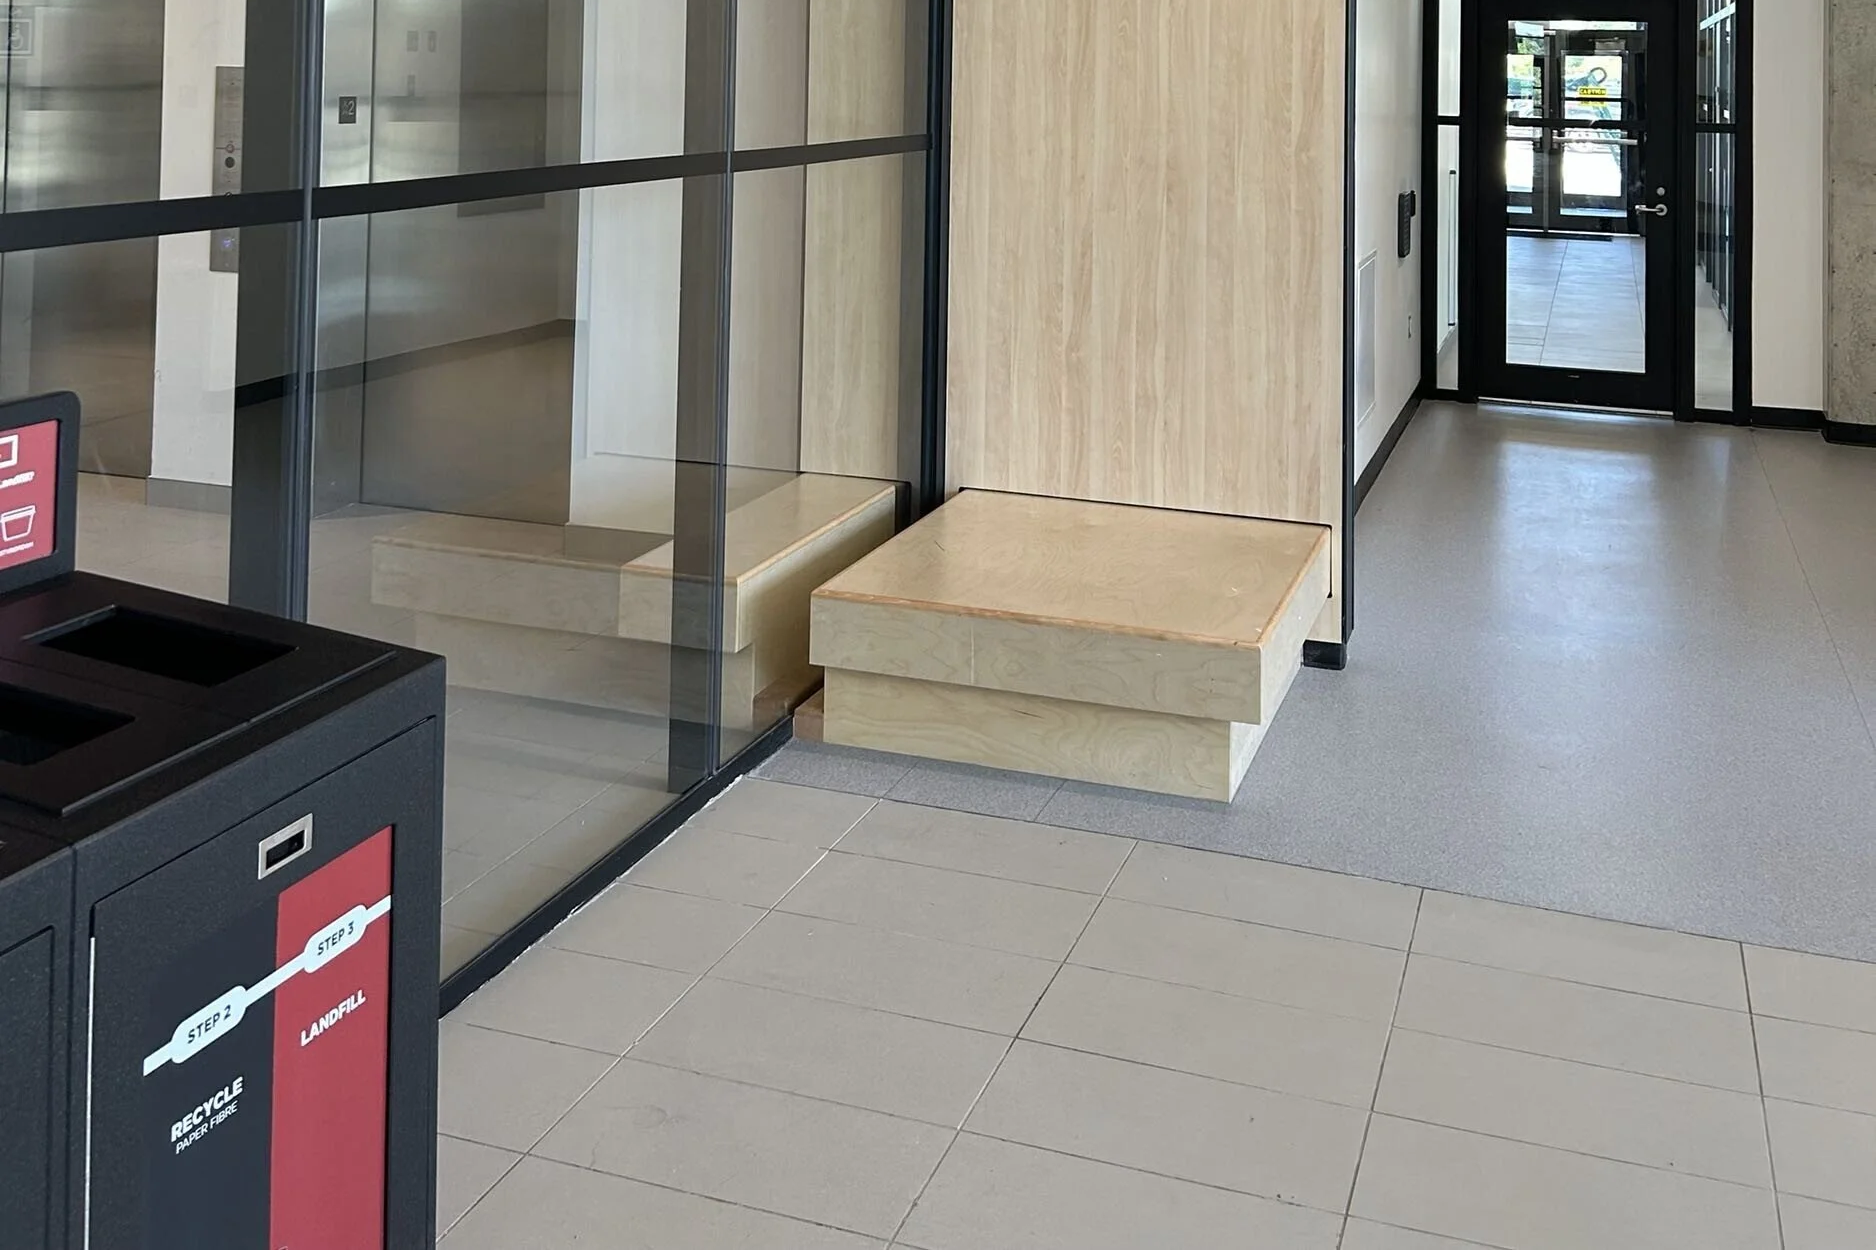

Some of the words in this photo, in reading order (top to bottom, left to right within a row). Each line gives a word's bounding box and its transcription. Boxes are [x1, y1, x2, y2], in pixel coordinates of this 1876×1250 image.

[317, 927, 345, 956] STEP
[347, 921, 355, 936] 3
[187, 1012, 221, 1044] STEP
[223, 1004, 232, 1021] 2
[300, 989, 367, 1047] LANDFILL
[171, 1076, 243, 1142] RECYCLE
[175, 1122, 209, 1155] PAPER
[209, 1100, 239, 1129] FIBRE
